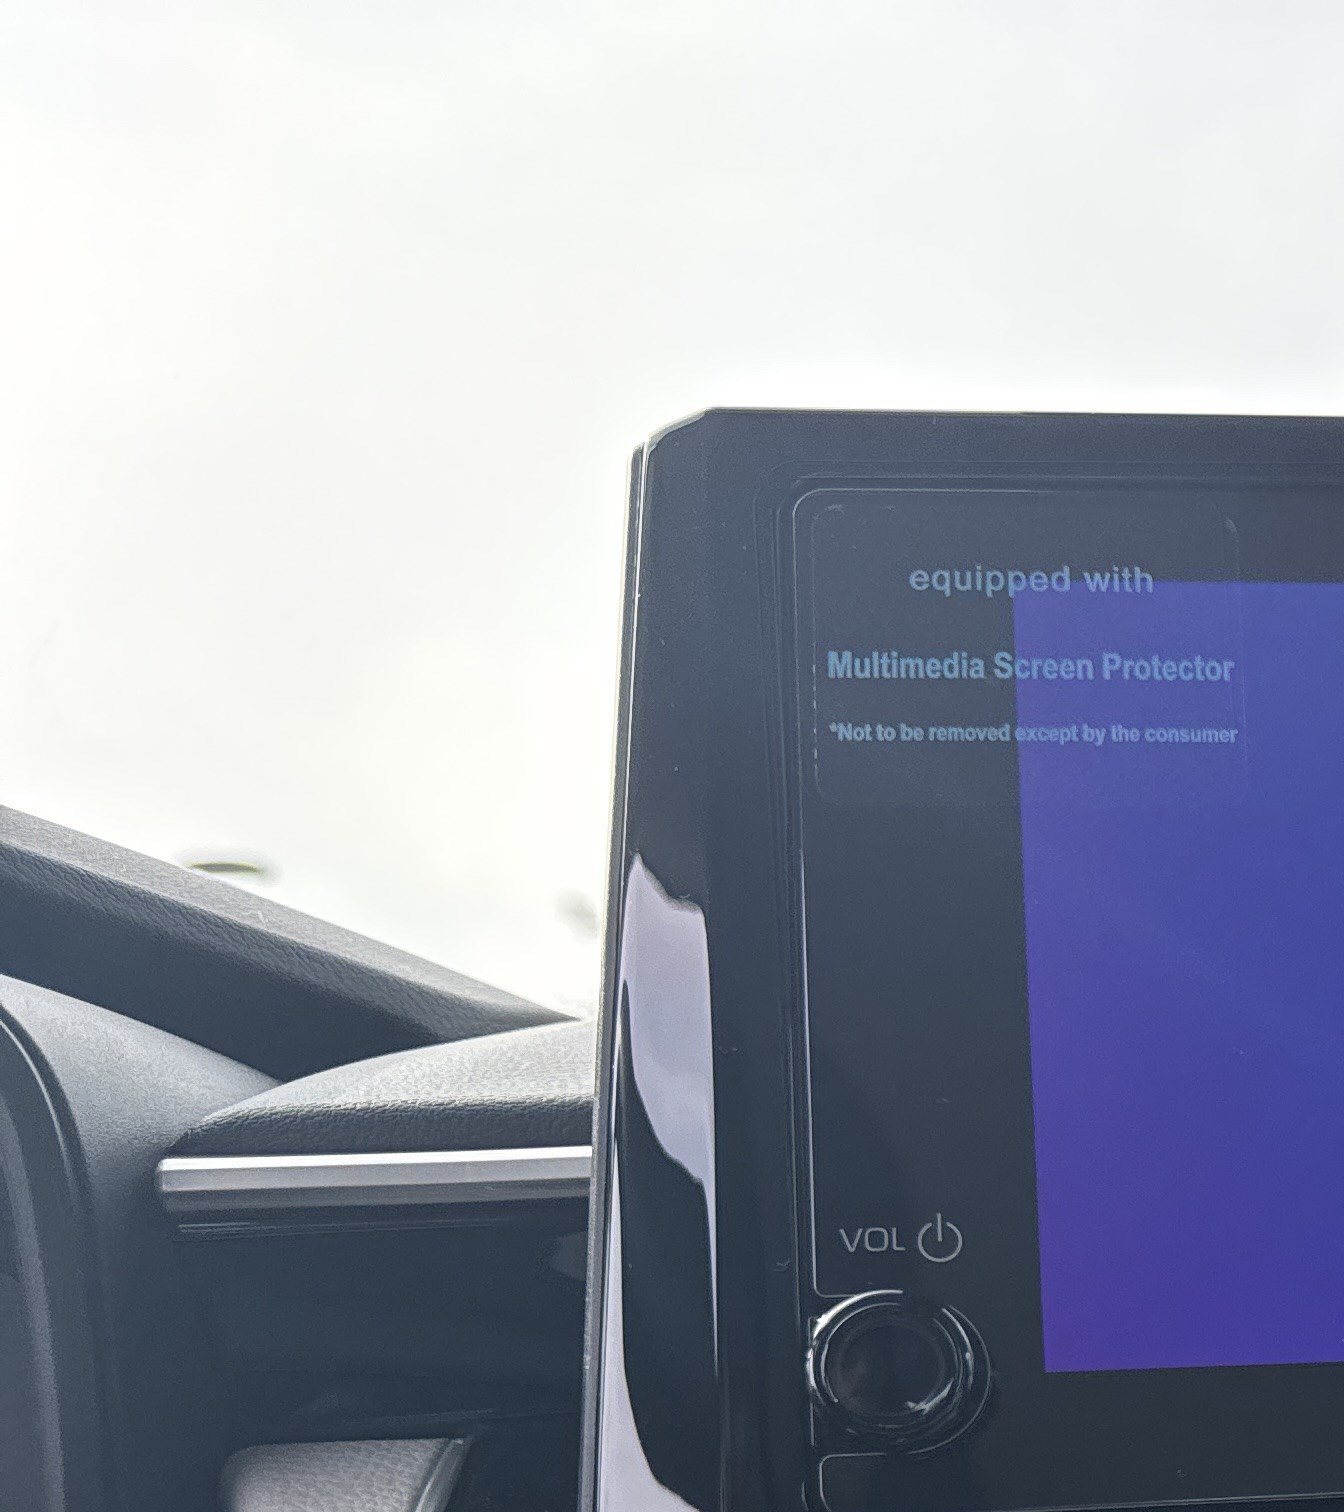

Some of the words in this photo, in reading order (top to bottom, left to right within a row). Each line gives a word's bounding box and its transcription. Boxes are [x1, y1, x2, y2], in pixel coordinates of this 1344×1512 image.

[909, 565, 1071, 597] equipped
[1083, 566, 1154, 594] with
[827, 650, 985, 679] Multimedia
[994, 652, 1094, 681] Screen
[1102, 653, 1235, 683] Protector
[876, 724, 896, 742] to
[901, 723, 924, 743] be
[928, 724, 1011, 743] removed
[1015, 725, 1079, 747] except
[1082, 725, 1106, 747] by
[1110, 725, 1140, 744] the
[1145, 727, 1239, 744] consumer
[839, 1227, 905, 1253] VOL
